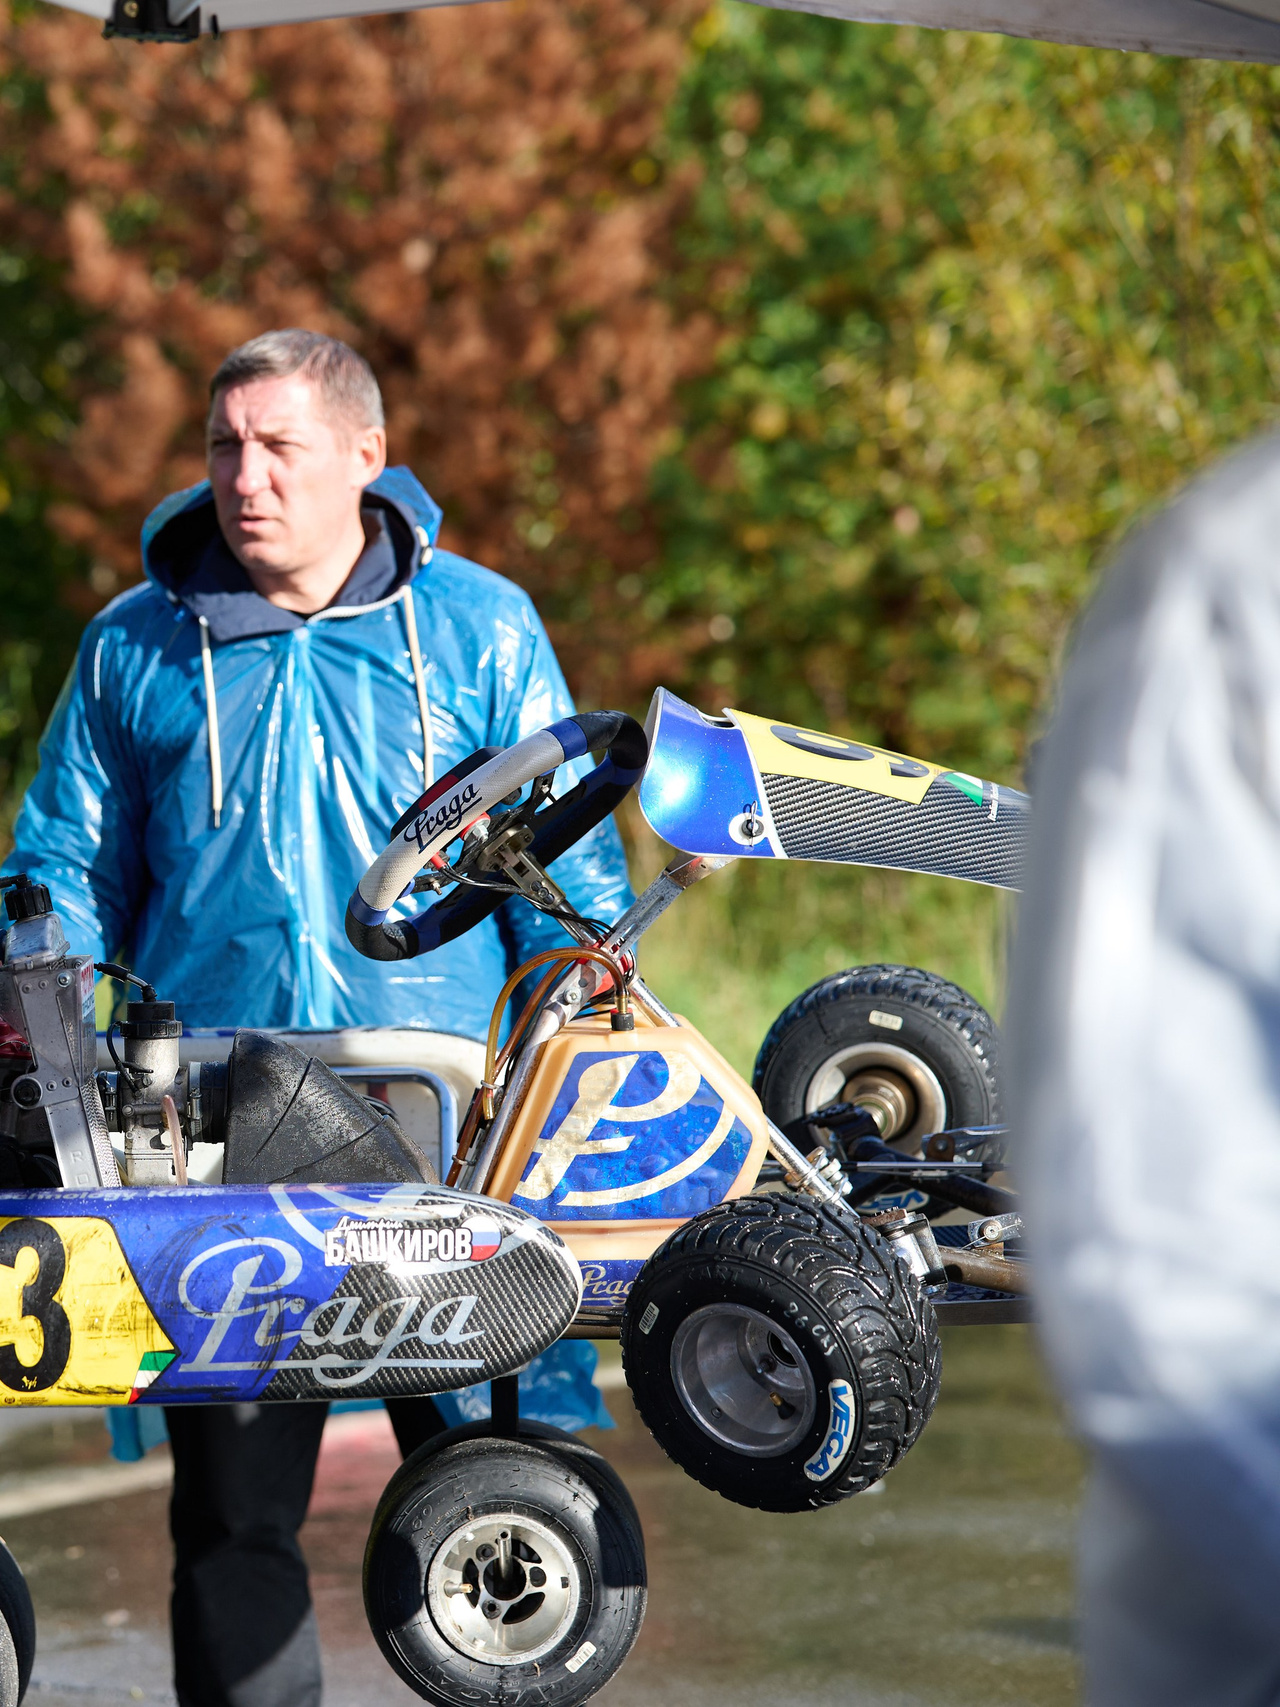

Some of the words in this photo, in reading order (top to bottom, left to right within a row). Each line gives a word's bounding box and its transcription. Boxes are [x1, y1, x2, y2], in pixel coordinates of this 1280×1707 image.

[403, 782, 483, 855] Praga
[325, 1228, 473, 1266] БАШКИРОВ
[177, 1236, 485, 1387] Praga
[805, 1384, 852, 1479] VEGA
